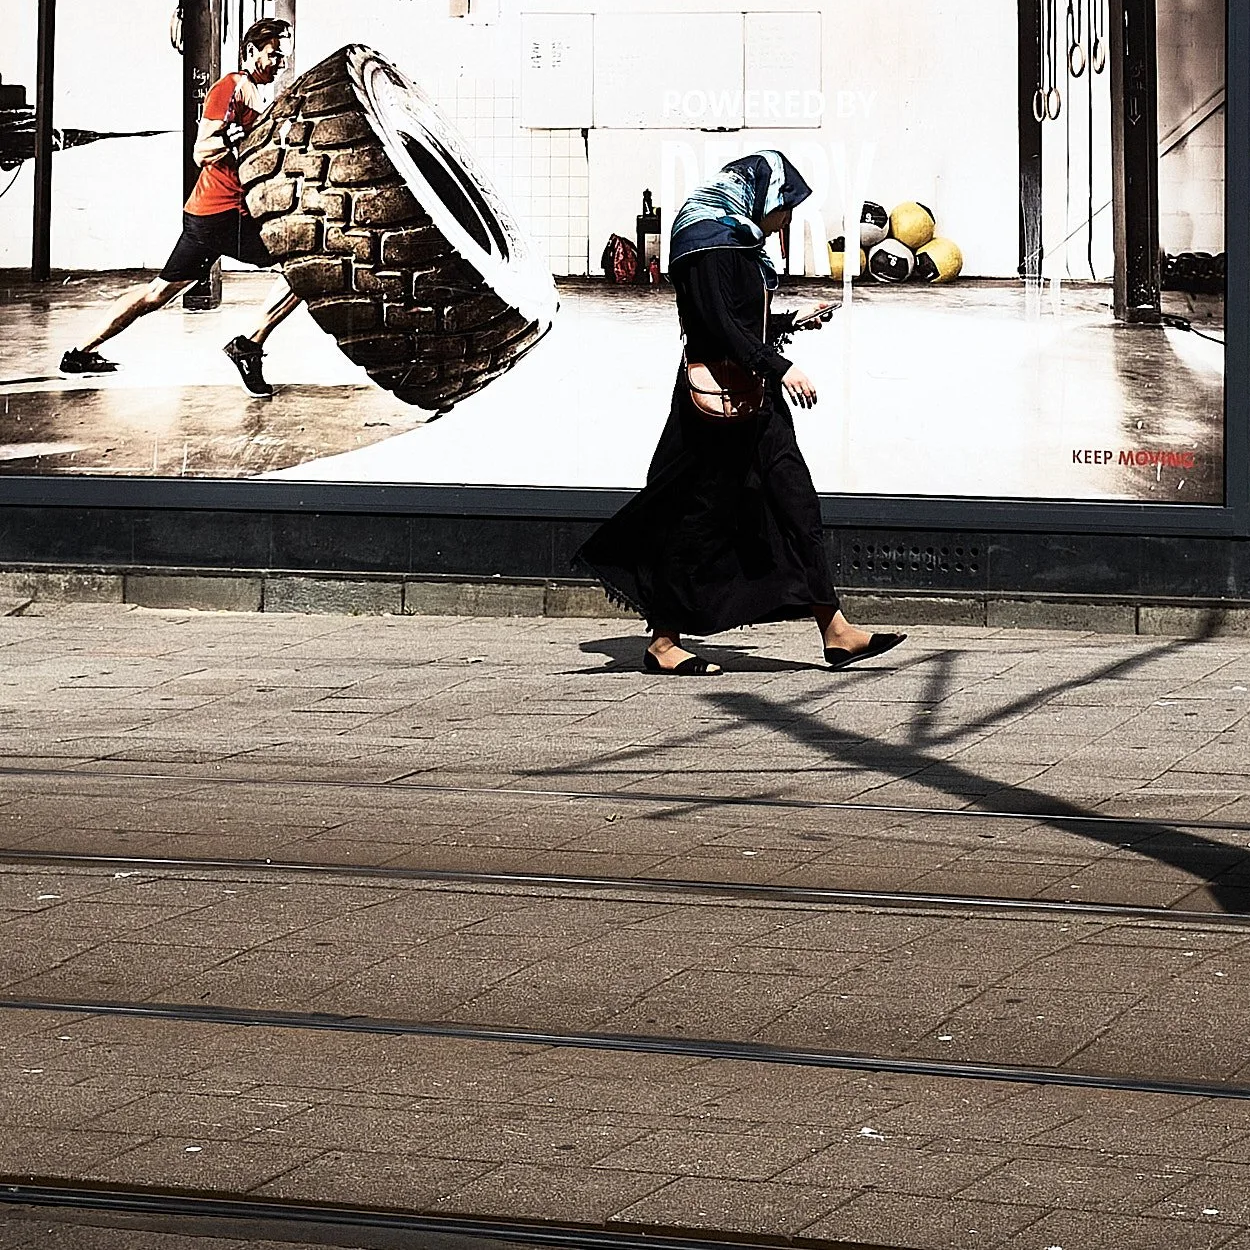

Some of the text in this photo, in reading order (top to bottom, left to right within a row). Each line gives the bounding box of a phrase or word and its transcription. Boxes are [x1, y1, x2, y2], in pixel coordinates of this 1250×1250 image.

[662, 89, 878, 119] POWERED BY
[1072, 449, 1196, 468] KEEP MOVING
